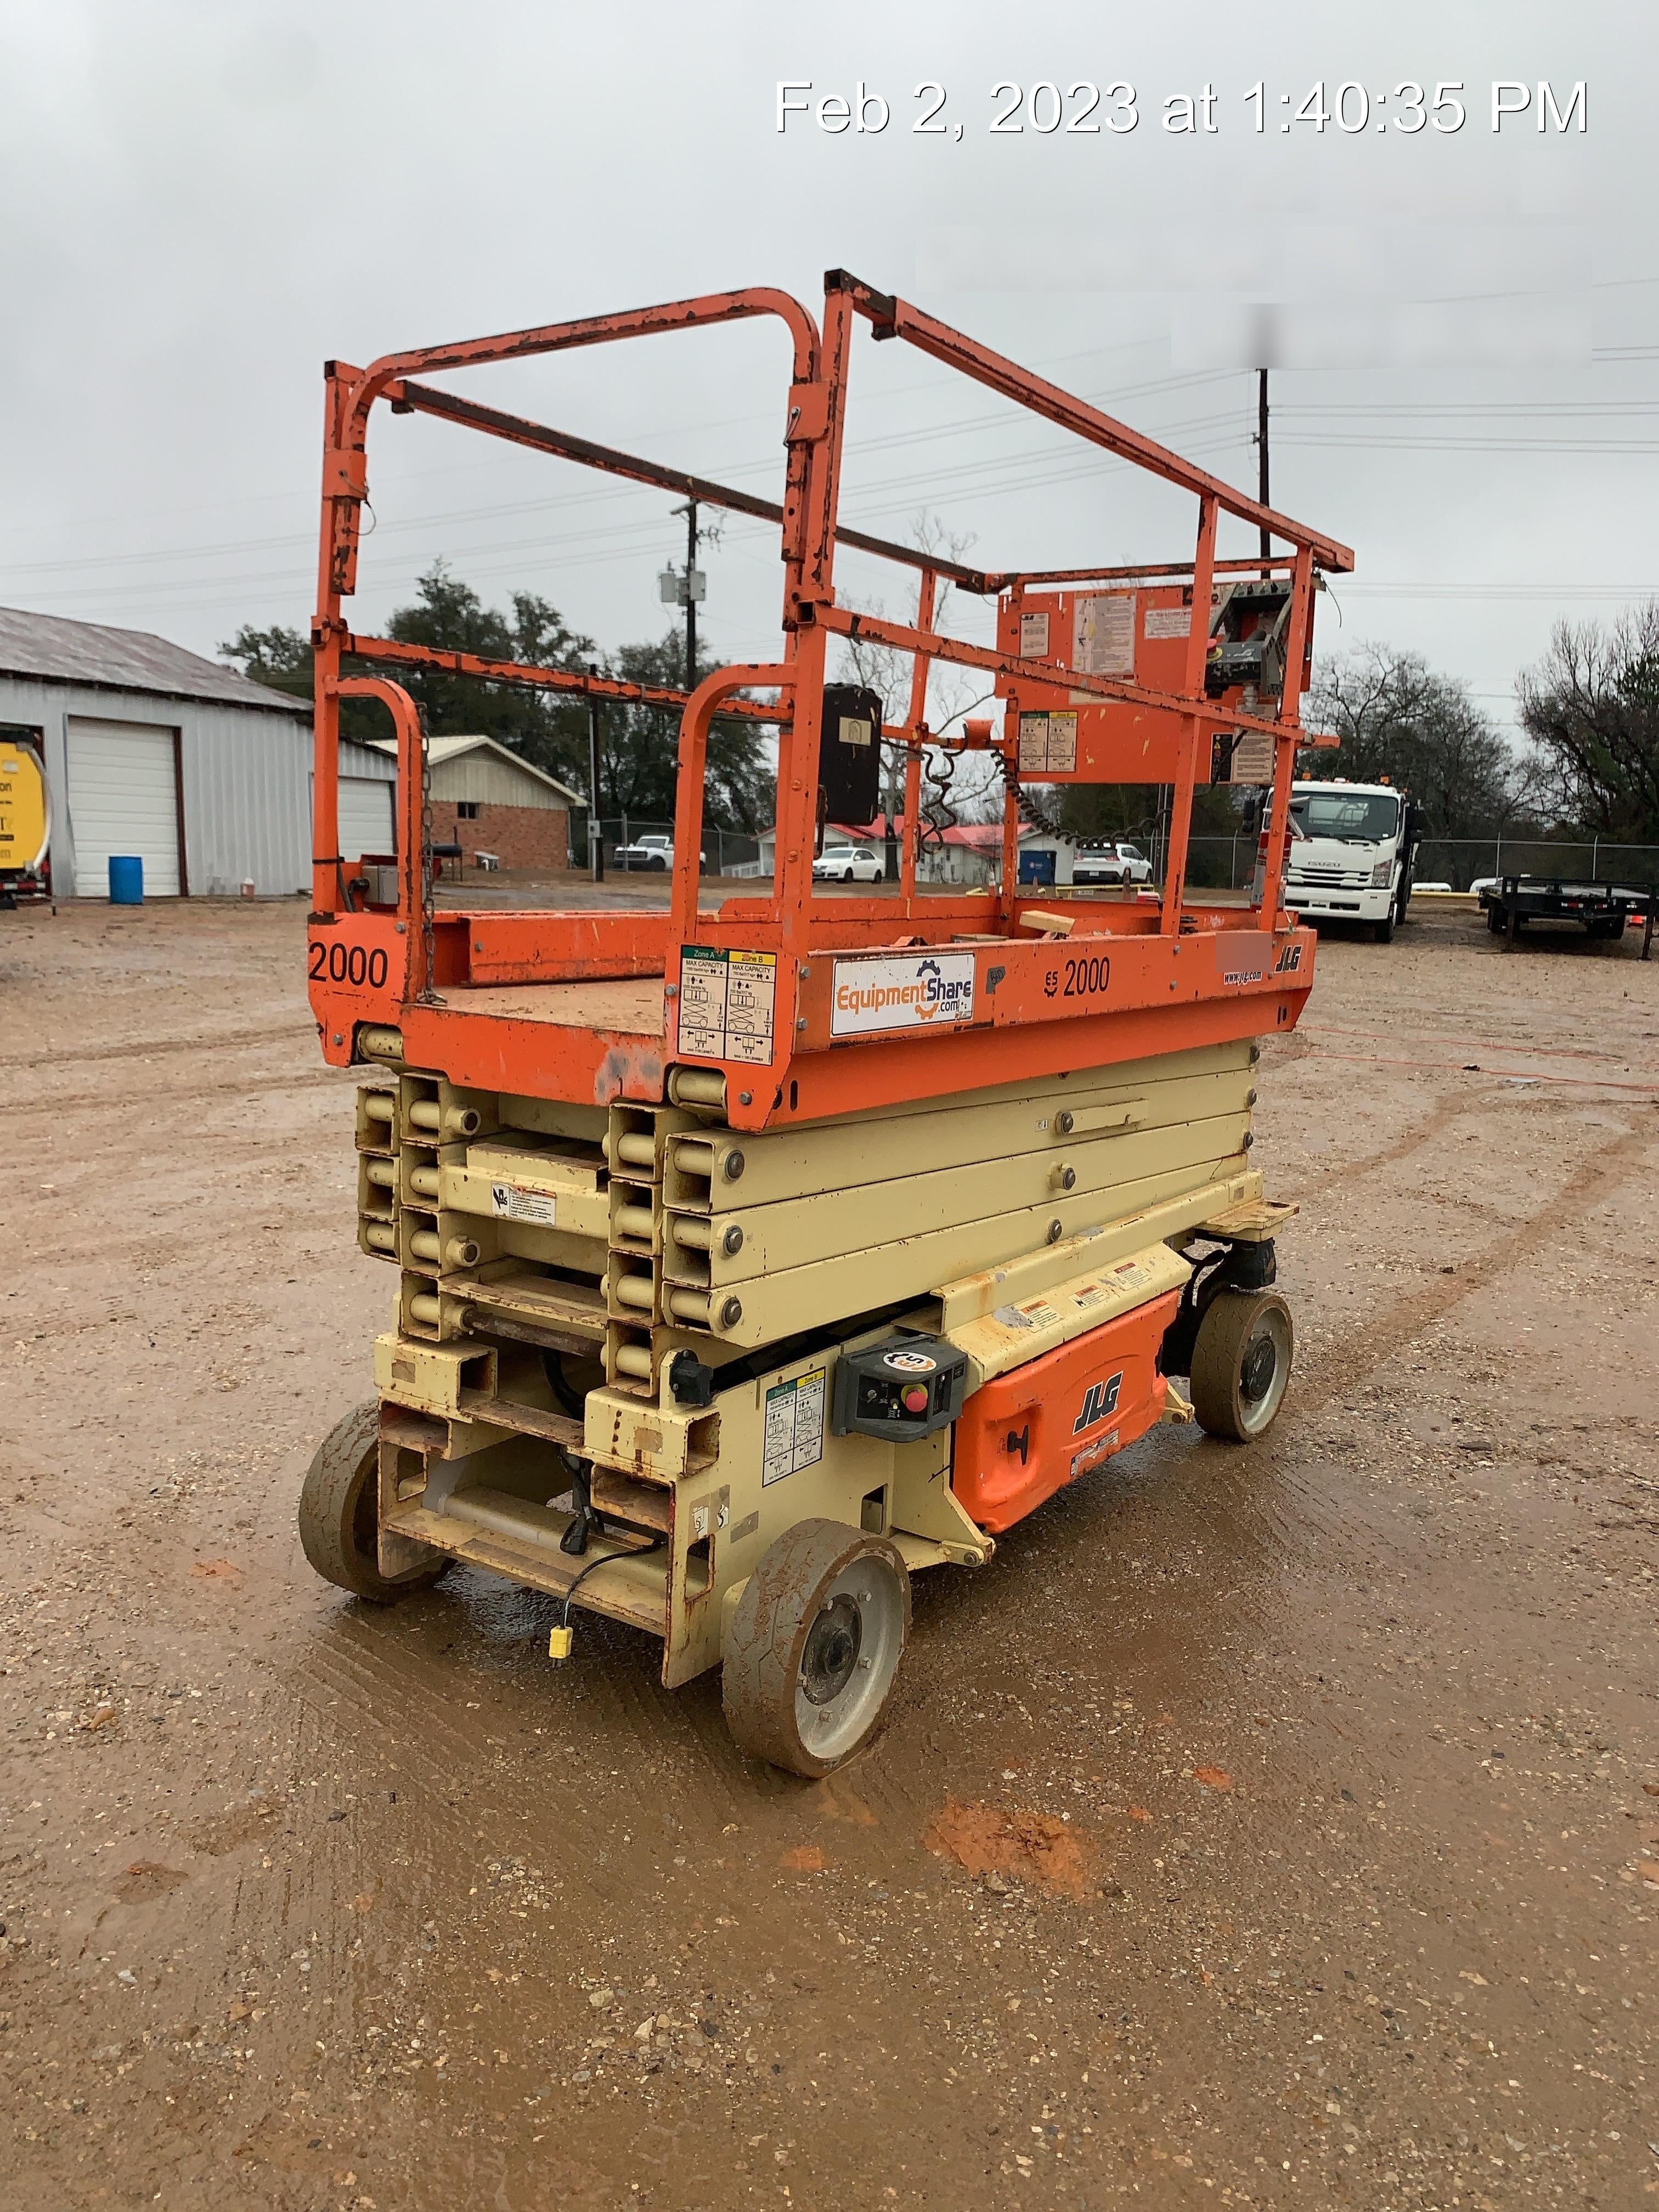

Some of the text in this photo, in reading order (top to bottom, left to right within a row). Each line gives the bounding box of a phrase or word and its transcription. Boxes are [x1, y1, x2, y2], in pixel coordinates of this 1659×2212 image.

[309, 942, 388, 988] 2000
[694, 950, 709, 958] Zone
[1274, 945, 1302, 973] JLG
[1046, 957, 1110, 996] ES 2000
[1224, 972, 1261, 983] www.jlg.com
[837, 978, 971, 1014] EquipmentShare
[938, 1001, 958, 1012] .com
[1074, 1371, 1123, 1435] JLG
